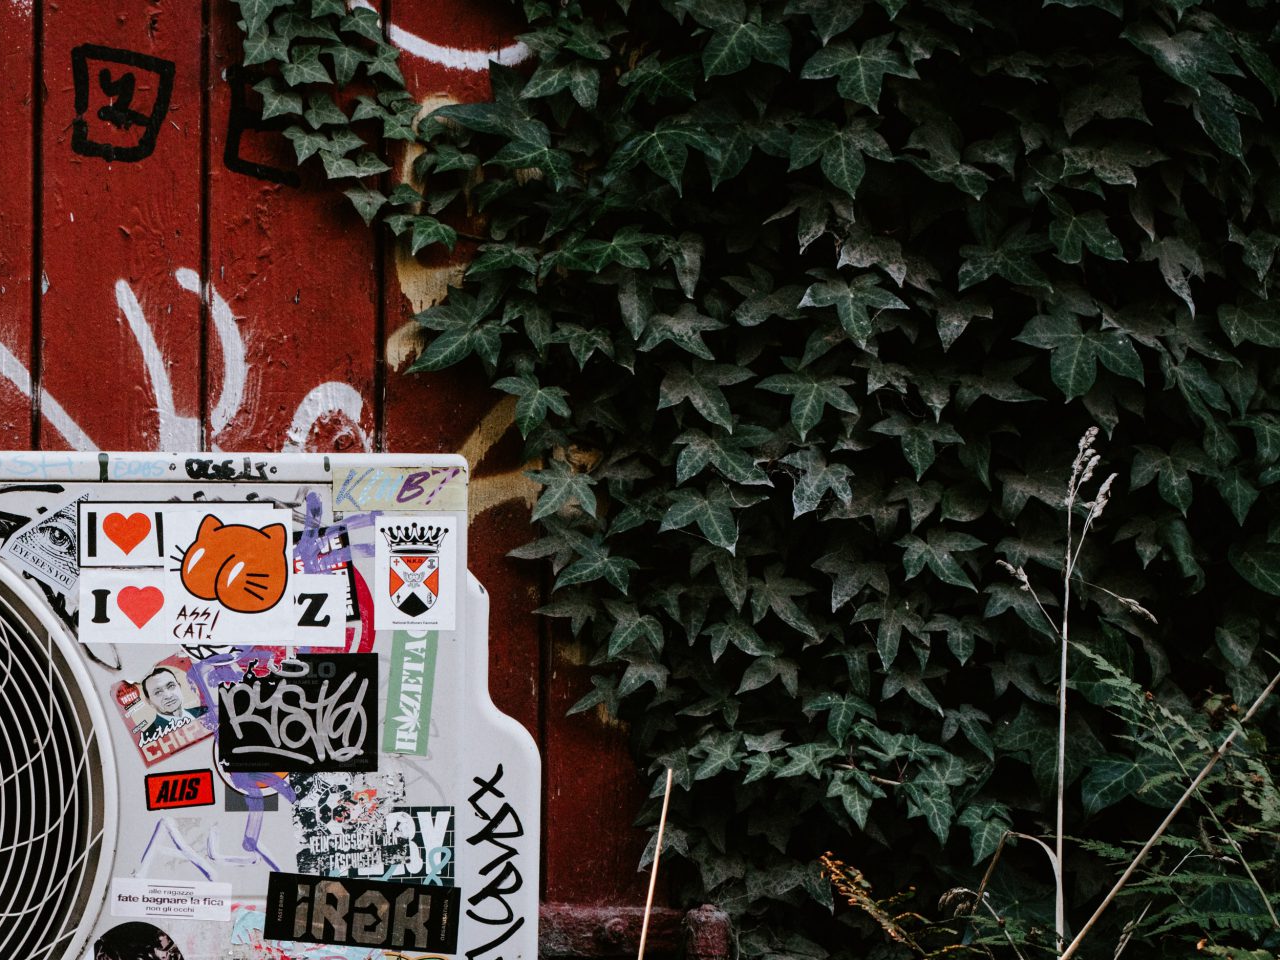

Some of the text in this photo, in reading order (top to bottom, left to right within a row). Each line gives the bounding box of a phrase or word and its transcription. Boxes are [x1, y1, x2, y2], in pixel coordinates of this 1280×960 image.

[13, 544, 73, 586] EYE SEE'S YOU
[139, 716, 192, 747] dictator
[155, 777, 201, 803] ALIS
[309, 834, 329, 852] KEIN
[117, 893, 224, 906] fate bagnare la fica
[163, 889, 194, 897] ragazze
